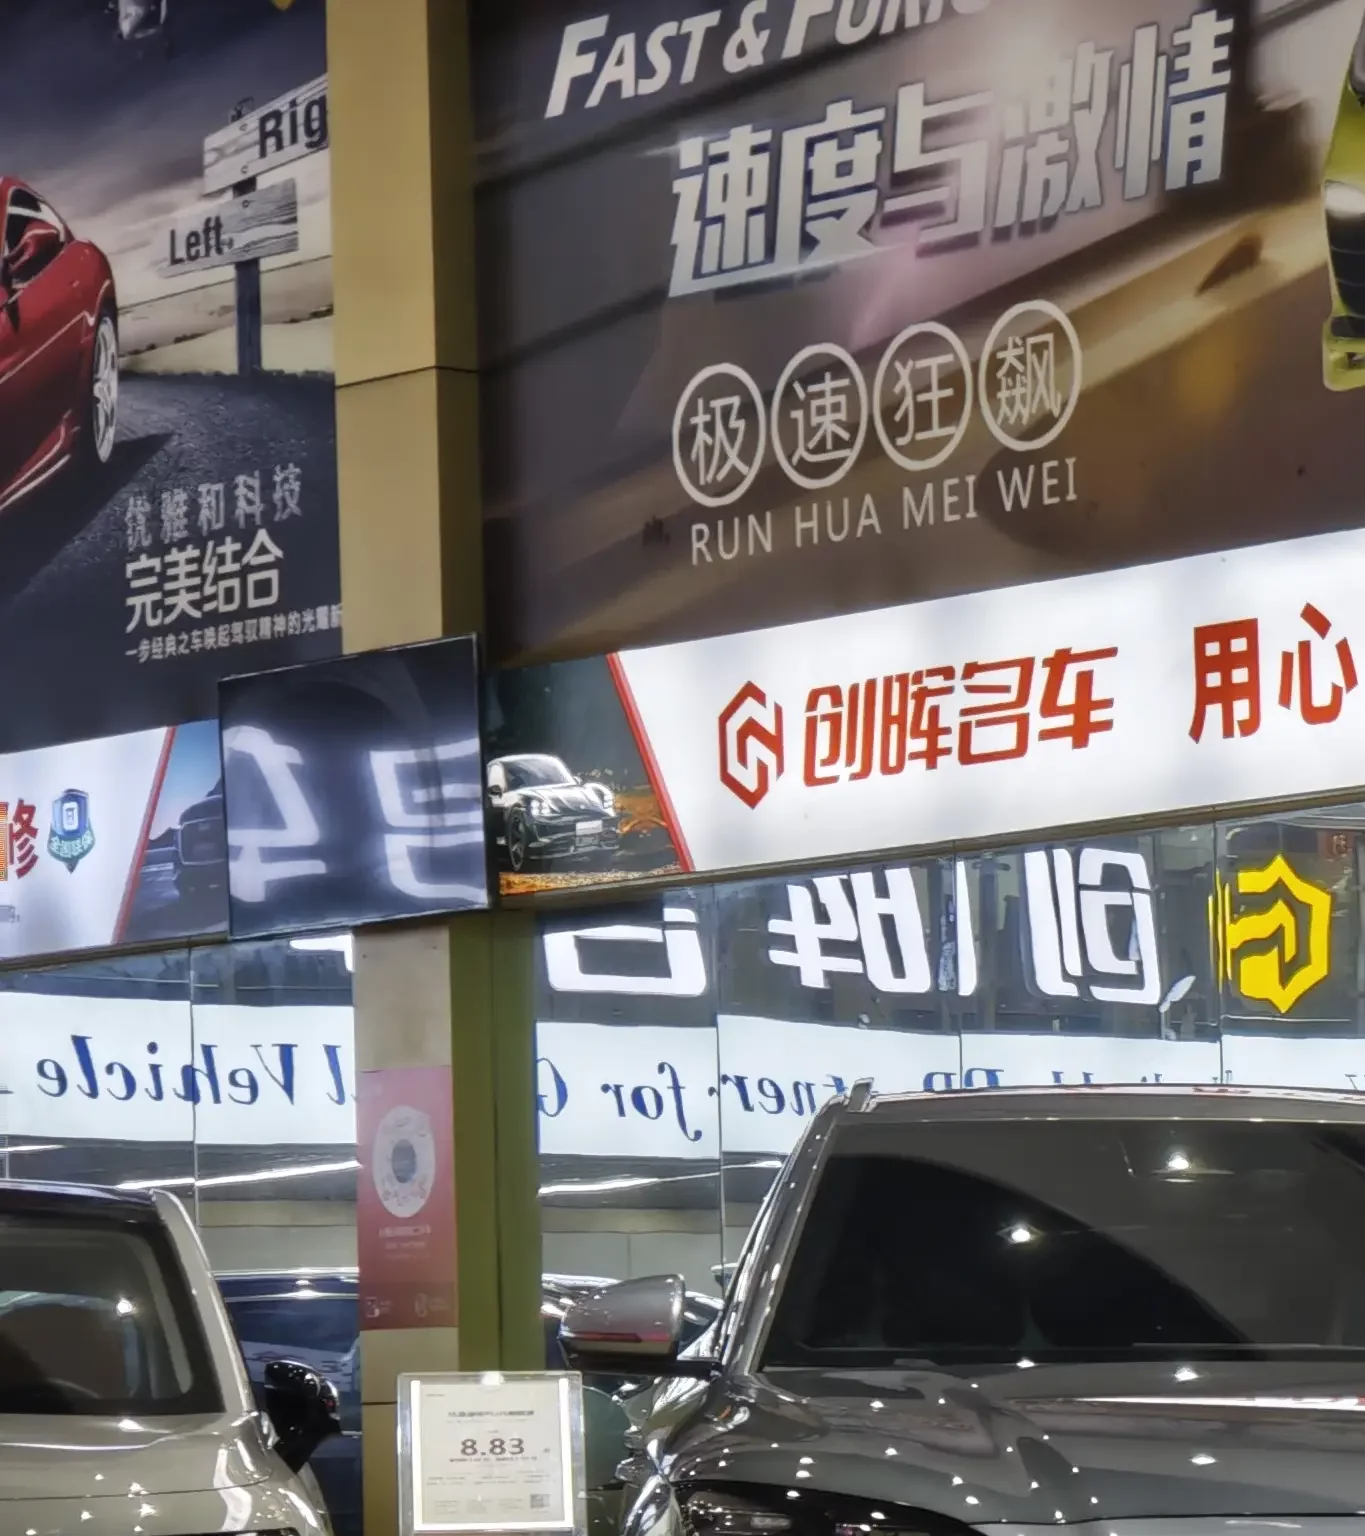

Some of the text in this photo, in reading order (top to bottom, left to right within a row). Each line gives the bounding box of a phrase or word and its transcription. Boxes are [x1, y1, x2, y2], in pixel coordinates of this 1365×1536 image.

[544, 10, 721, 119] FAST
[669, 9, 1234, 297] 速度与激情
[690, 457, 1077, 566] RUN HUA MEI WEI
[126, 528, 284, 634] 完美结合
[803, 646, 1119, 788] 创晖名车
[460, 1438, 525, 1457] 8.83
